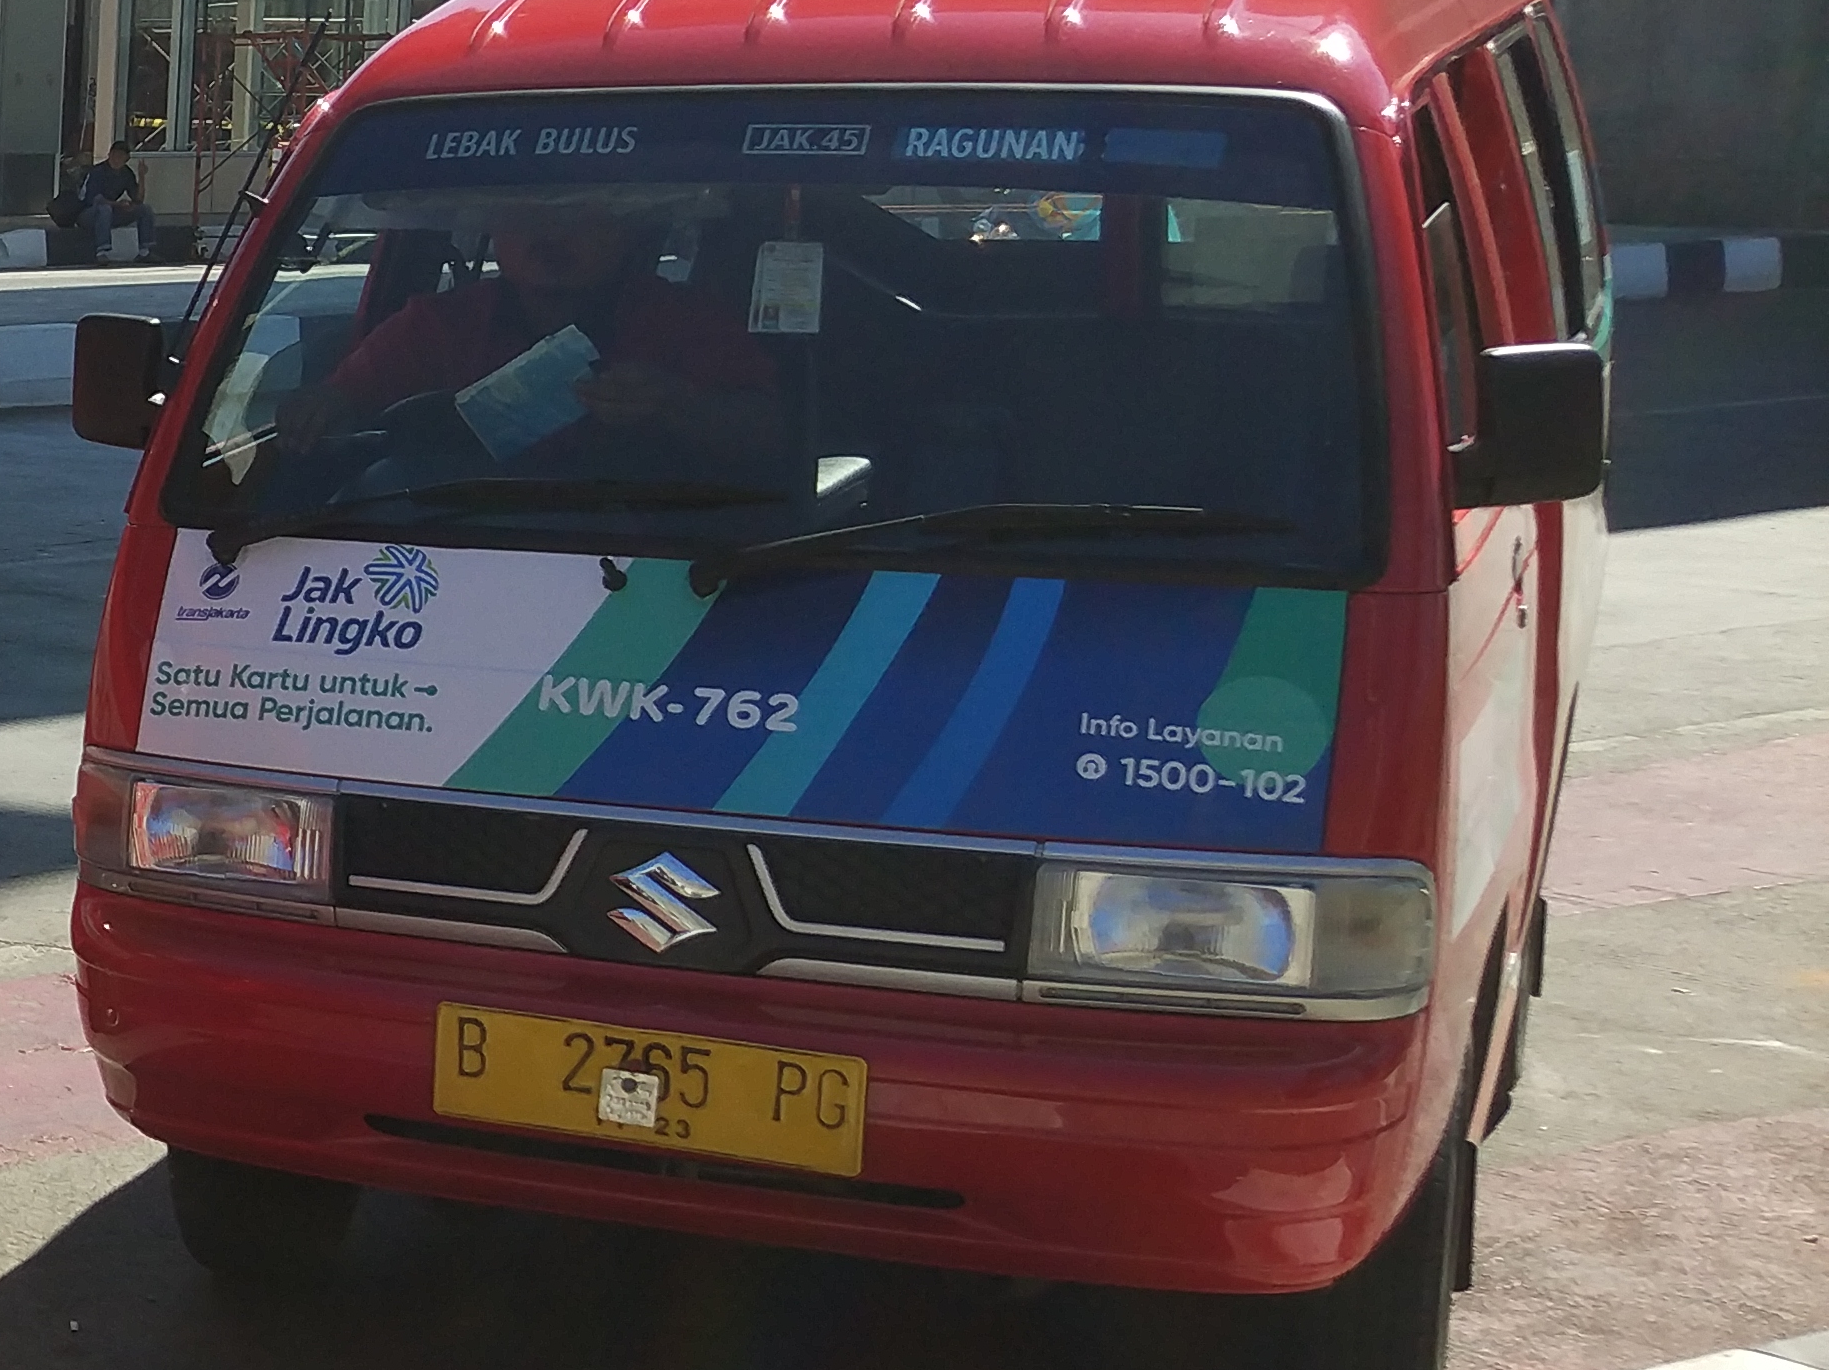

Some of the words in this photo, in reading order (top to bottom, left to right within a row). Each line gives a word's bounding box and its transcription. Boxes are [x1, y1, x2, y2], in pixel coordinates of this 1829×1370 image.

[426, 129, 521, 160] LEBAK
[535, 126, 637, 155] BULUS
[905, 128, 1078, 160] RAGUNAN
[281, 566, 363, 605] Jak
[175, 605, 250, 621] transjakarta
[272, 606, 423, 656] Lingko
[154, 661, 220, 687] Satu
[230, 664, 310, 693] Kartu
[319, 671, 407, 699] untuk
[149, 692, 249, 721] Semua
[258, 696, 433, 733] Perjalanan.
[538, 675, 800, 734] KWK-762
[1079, 712, 1139, 741] Info
[1146, 715, 1285, 755] Layanan
[1120, 756, 1307, 805] 1500-102
[457, 1016, 488, 1078] B
[772, 1059, 850, 1130] PG
